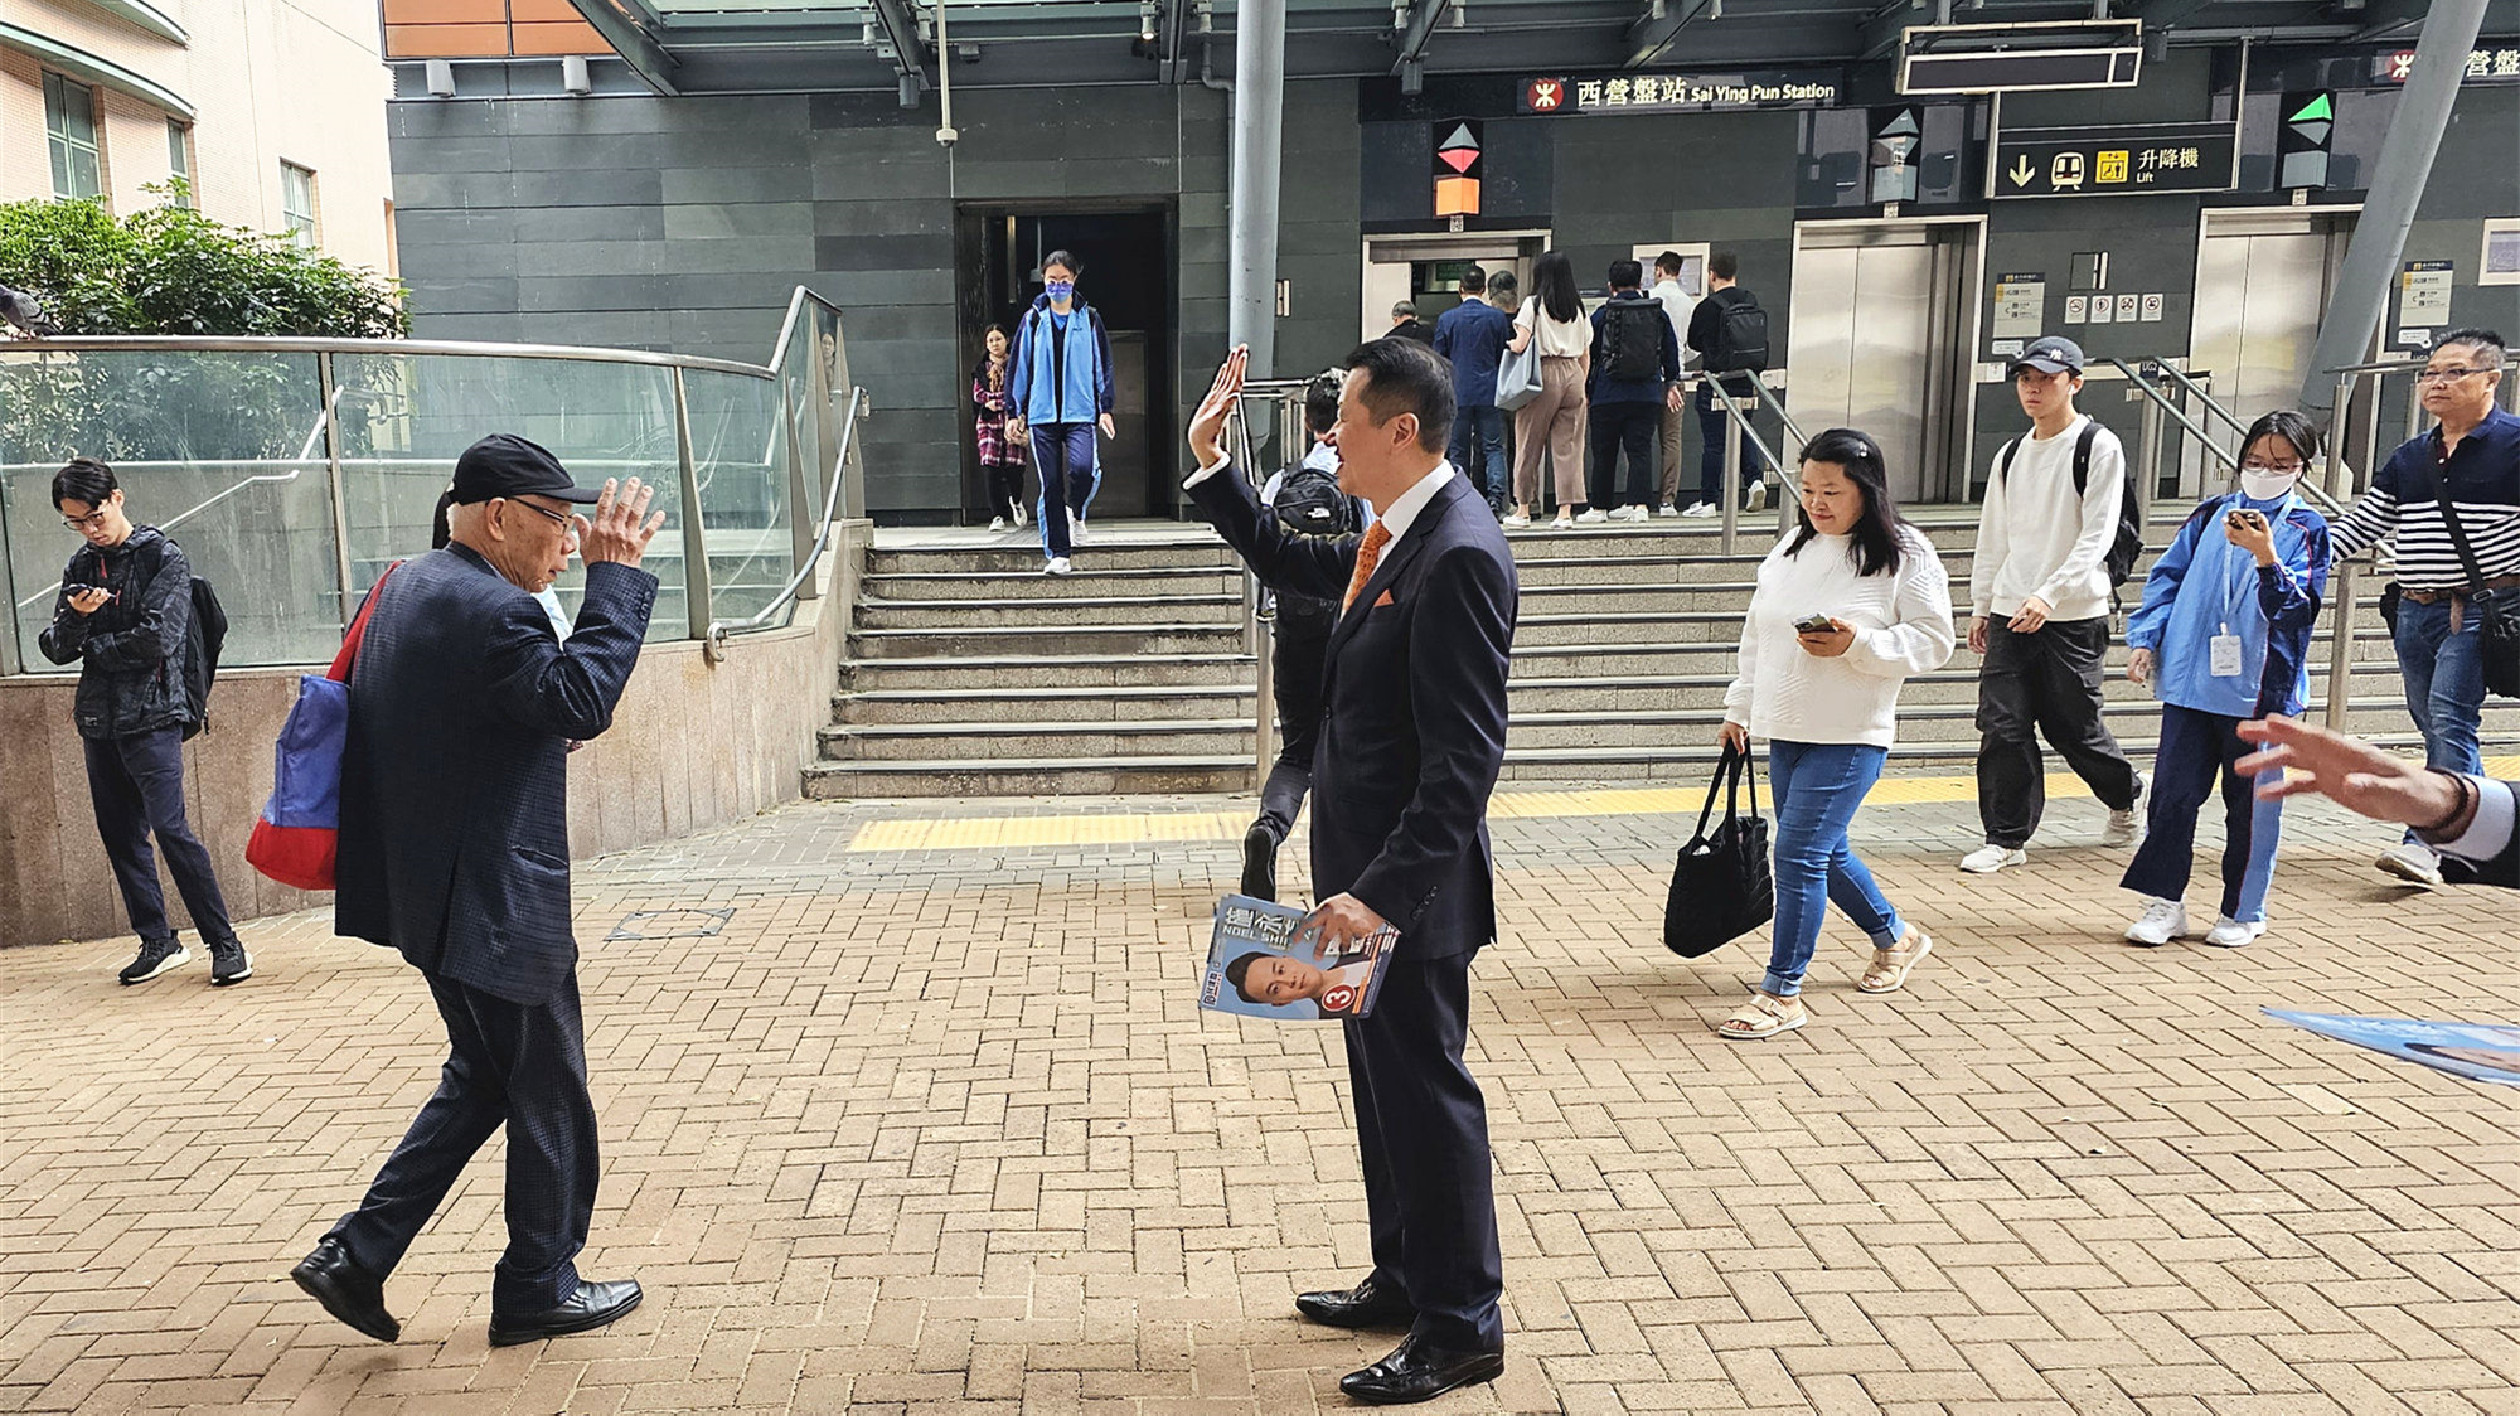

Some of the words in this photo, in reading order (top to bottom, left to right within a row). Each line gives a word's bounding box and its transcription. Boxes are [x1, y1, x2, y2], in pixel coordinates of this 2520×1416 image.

[1578, 76, 1687, 106] 西營盤站
[1691, 86, 1712, 102] Sai
[1715, 85, 1749, 104] Ying
[1751, 85, 1780, 101] Pun
[1782, 83, 1834, 99] Station
[2138, 147, 2199, 169] 升降機
[2136, 171, 2153, 184] Lift
[1326, 990, 1351, 1005] 3
